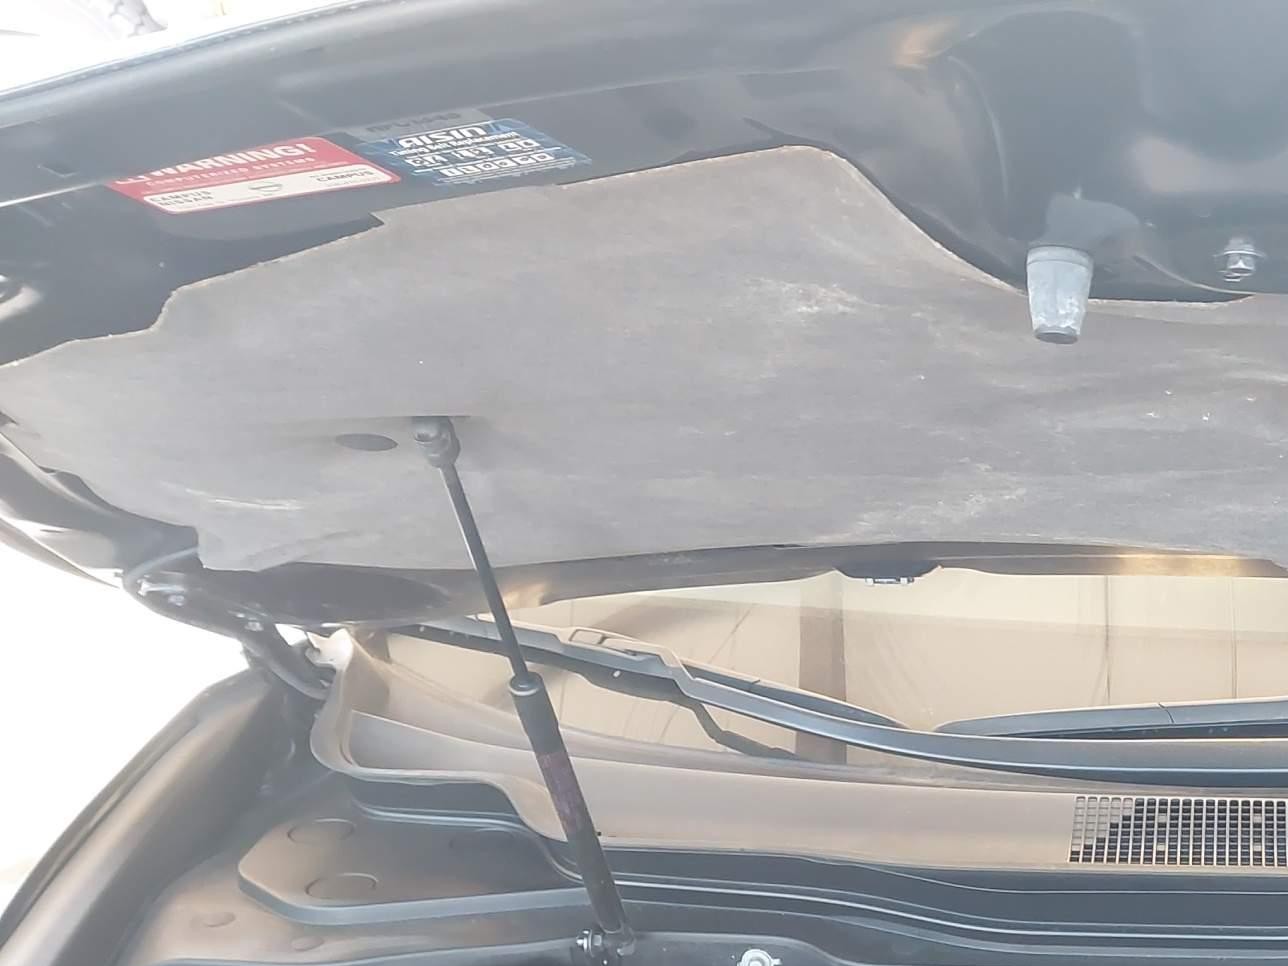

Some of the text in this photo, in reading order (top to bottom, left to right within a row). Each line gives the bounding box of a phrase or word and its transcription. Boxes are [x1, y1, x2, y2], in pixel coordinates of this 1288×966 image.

[151, 143, 317, 177] WARNING!
[252, 156, 316, 171] SYSTEMS
[316, 170, 376, 183] CAMPUS
